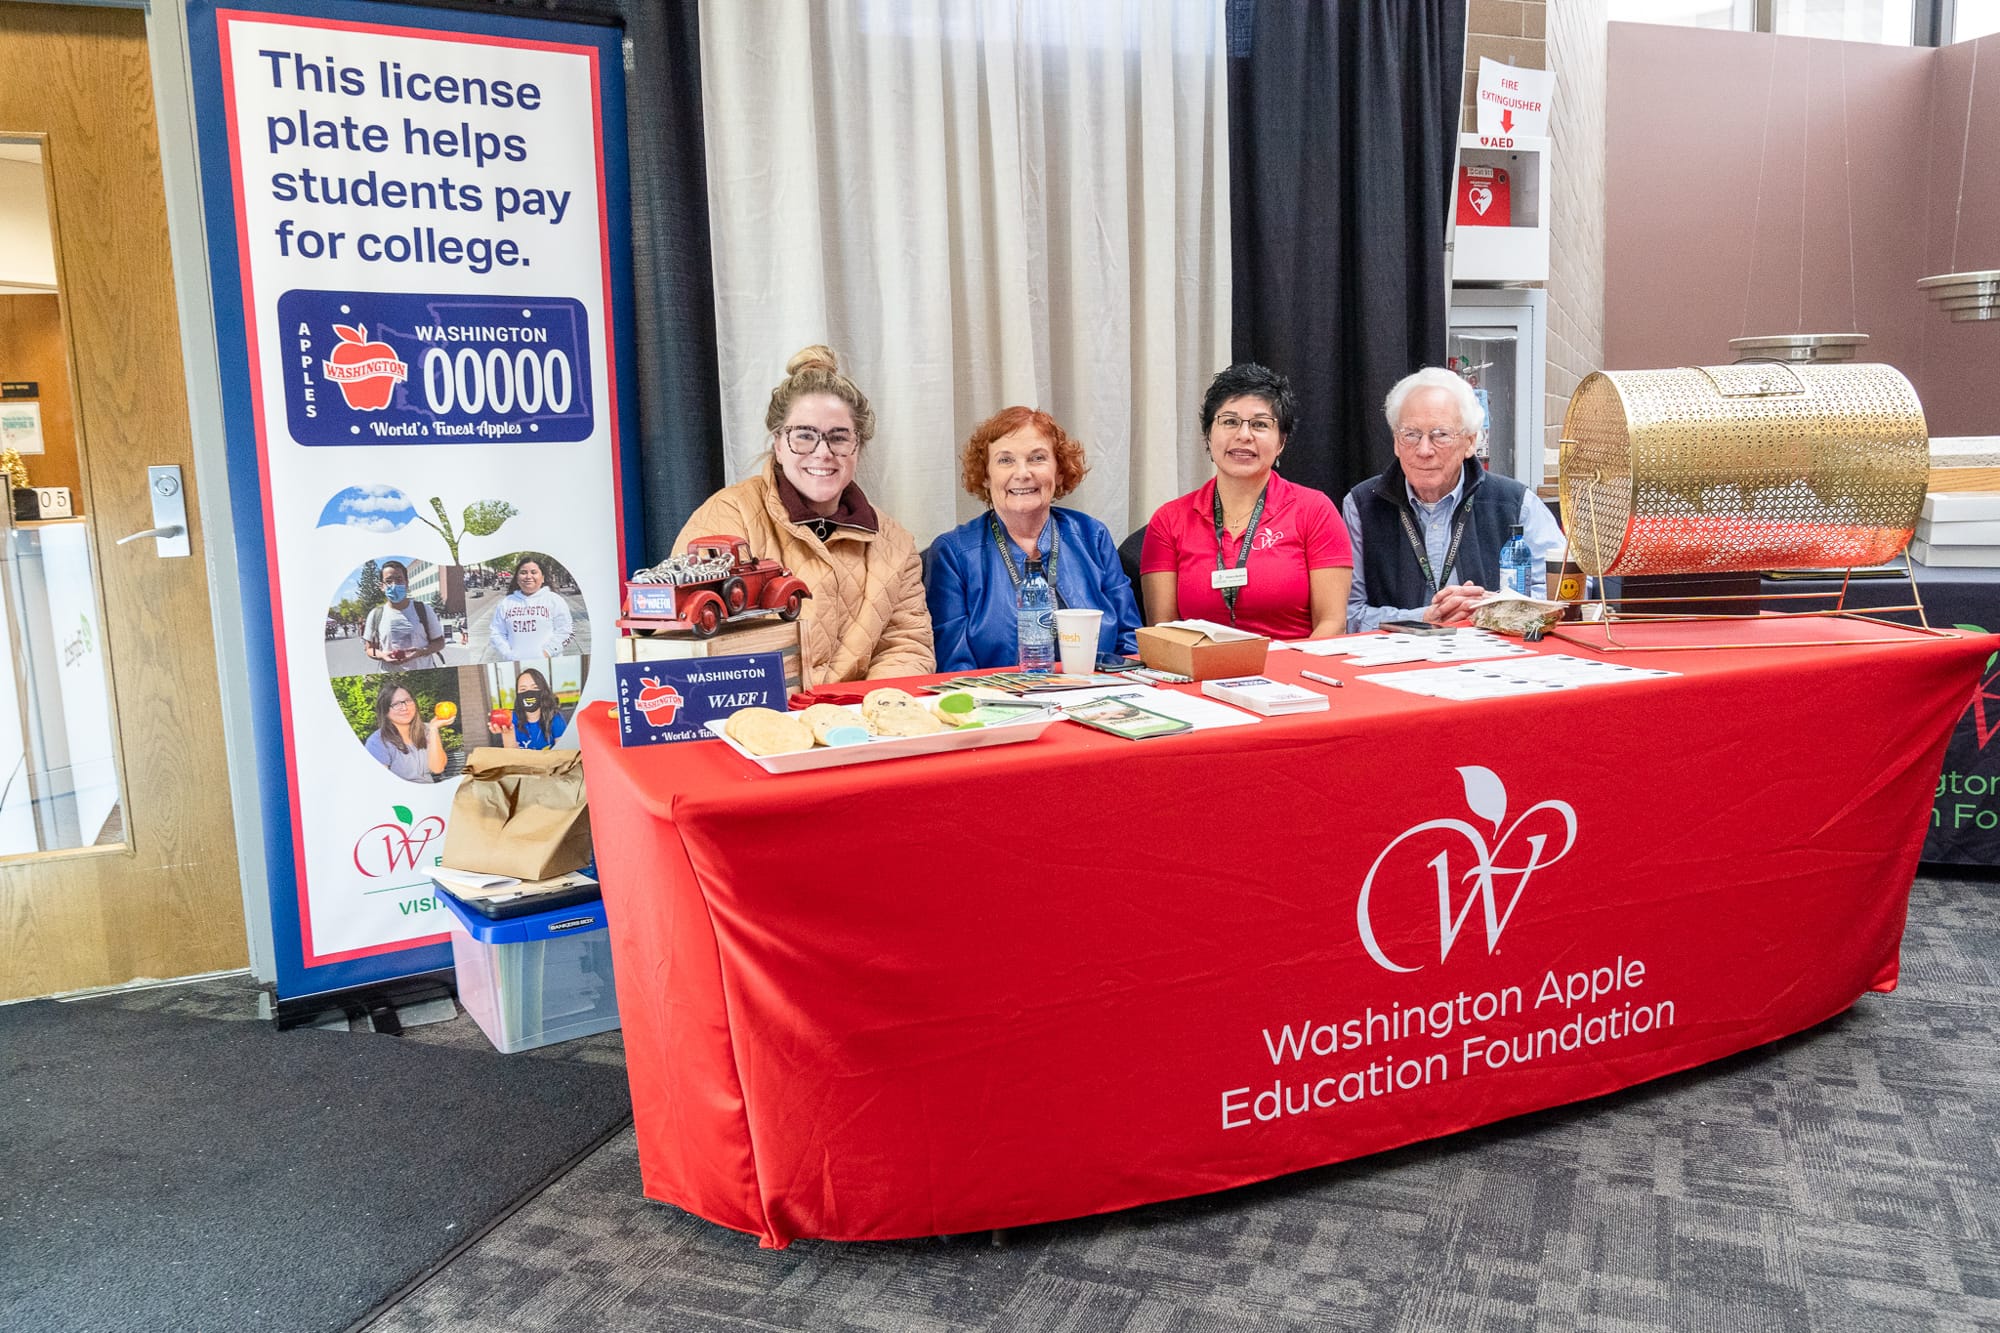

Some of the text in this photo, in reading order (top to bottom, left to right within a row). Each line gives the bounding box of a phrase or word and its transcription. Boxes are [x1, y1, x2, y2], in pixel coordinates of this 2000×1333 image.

[258, 49, 542, 111] This license
[1501, 78, 1520, 91] FIRE
[1481, 89, 1542, 113] EXTINGUISHER
[266, 109, 528, 168] plate helps
[1490, 137, 1514, 148] AED
[271, 168, 571, 225] students pay
[274, 219, 531, 274] for college.
[415, 325, 548, 343] WASHINGTON
[298, 322, 318, 419] APPLES
[324, 360, 406, 379] WASHINGTON
[423, 348, 573, 414] 00000
[432, 420, 475, 437] Finest
[475, 421, 522, 438] Apples
[512, 619, 537, 633] STATE
[686, 668, 766, 684] WASHINGTON
[620, 678, 633, 734] APPLES
[636, 695, 683, 711] WASHINGTON
[707, 691, 759, 709] WAEF
[1262, 955, 1647, 1067] Washington Apple
[1221, 1000, 1676, 1130] Education Foundation
